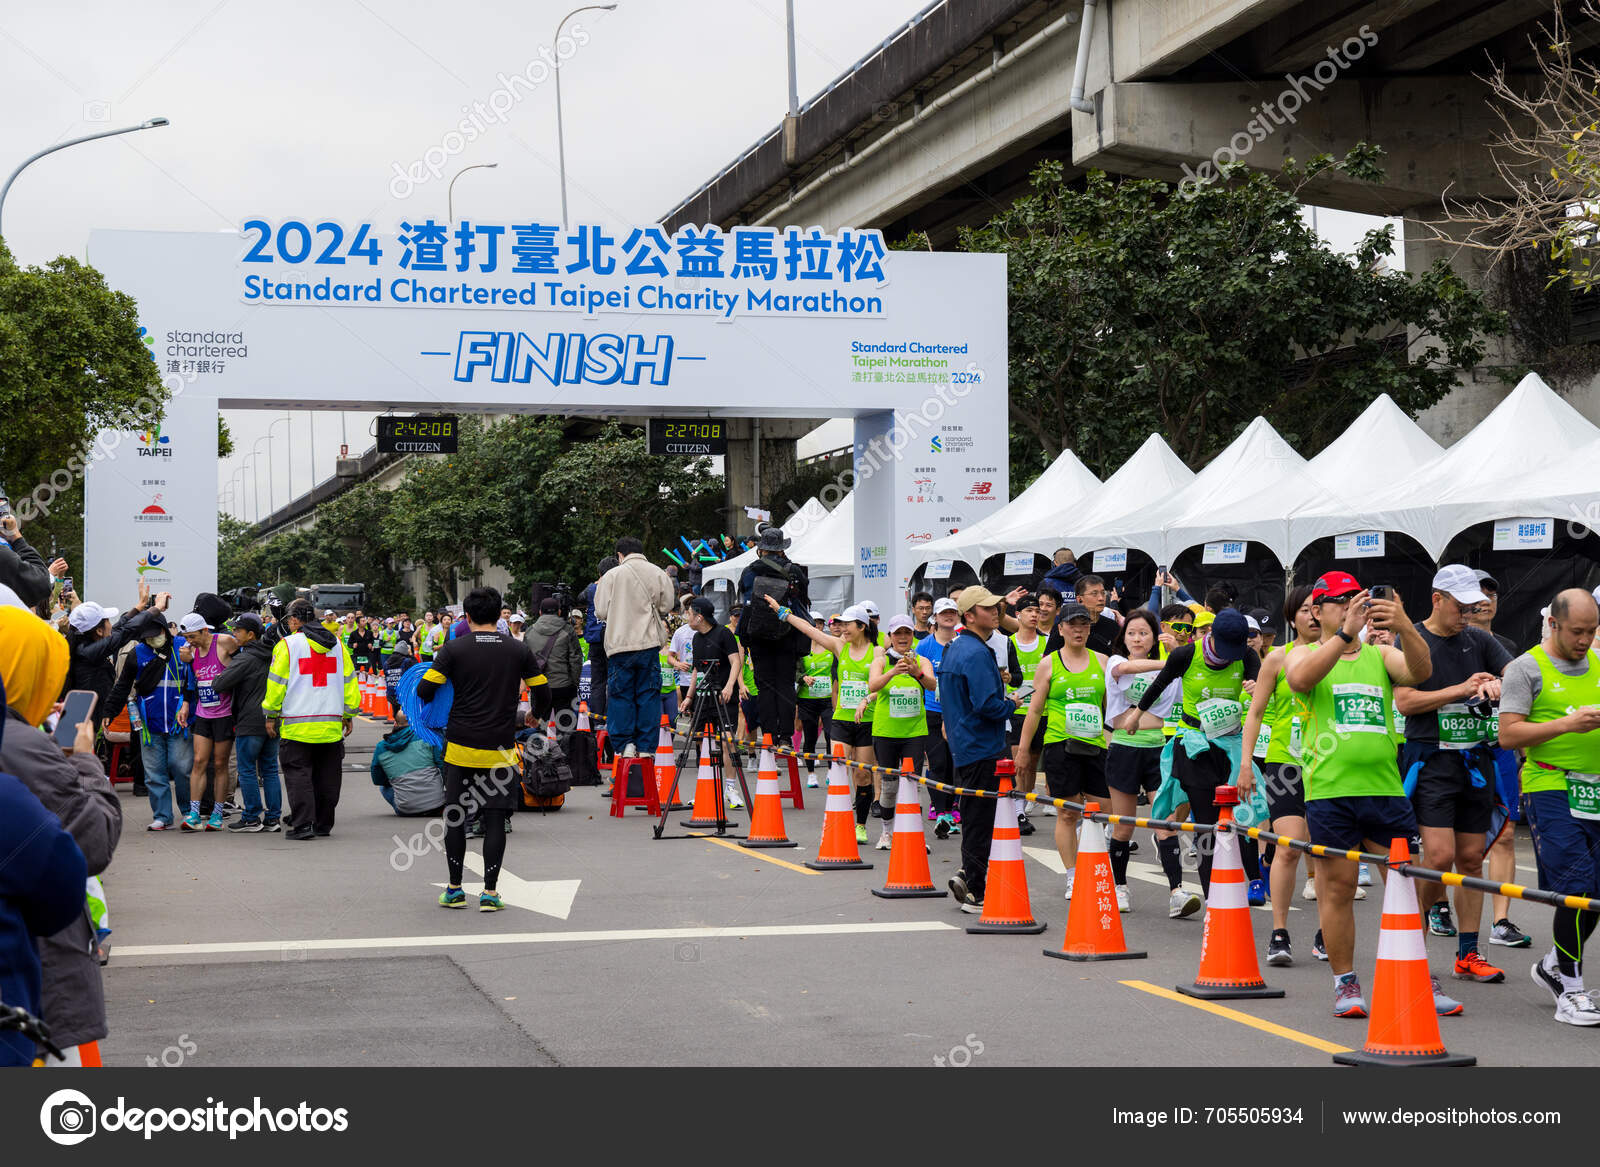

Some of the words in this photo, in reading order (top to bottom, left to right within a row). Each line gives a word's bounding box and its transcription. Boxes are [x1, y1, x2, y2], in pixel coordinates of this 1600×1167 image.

[242, 220, 383, 265] 2024
[397, 219, 886, 283] 渣打臺北公益馬拉松
[244, 275, 382, 302] Standard
[390, 279, 536, 306] Chartered
[544, 282, 630, 314] Taipei
[637, 285, 739, 318] Charity
[747, 287, 882, 313] Marathon
[166, 330, 243, 344] standard
[166, 344, 248, 358] chartered
[851, 341, 907, 353] Standard
[909, 342, 968, 354] Chartered
[454, 331, 674, 387] FINISH
[851, 355, 887, 369] Taipei
[889, 356, 948, 368] Marathon
[167, 360, 225, 373] 渣打銀行
[951, 372, 982, 384] 2024
[394, 422, 452, 436] 2:42:08
[665, 424, 721, 438] 2:27:08
[136, 447, 172, 457] TAIPEI
[395, 442, 441, 451] CITIZEN
[666, 443, 710, 453] CITIZEN
[861, 546, 872, 561] RUN
[861, 563, 888, 578] TOGETHER
[841, 689, 866, 697] 14135
[892, 698, 918, 706] 16068
[1338, 698, 1381, 713] 13226
[1069, 712, 1099, 724] 16405
[1202, 704, 1239, 723] 15853
[1441, 717, 1482, 731] 08287
[1094, 863, 1113, 930] 路跑協會
